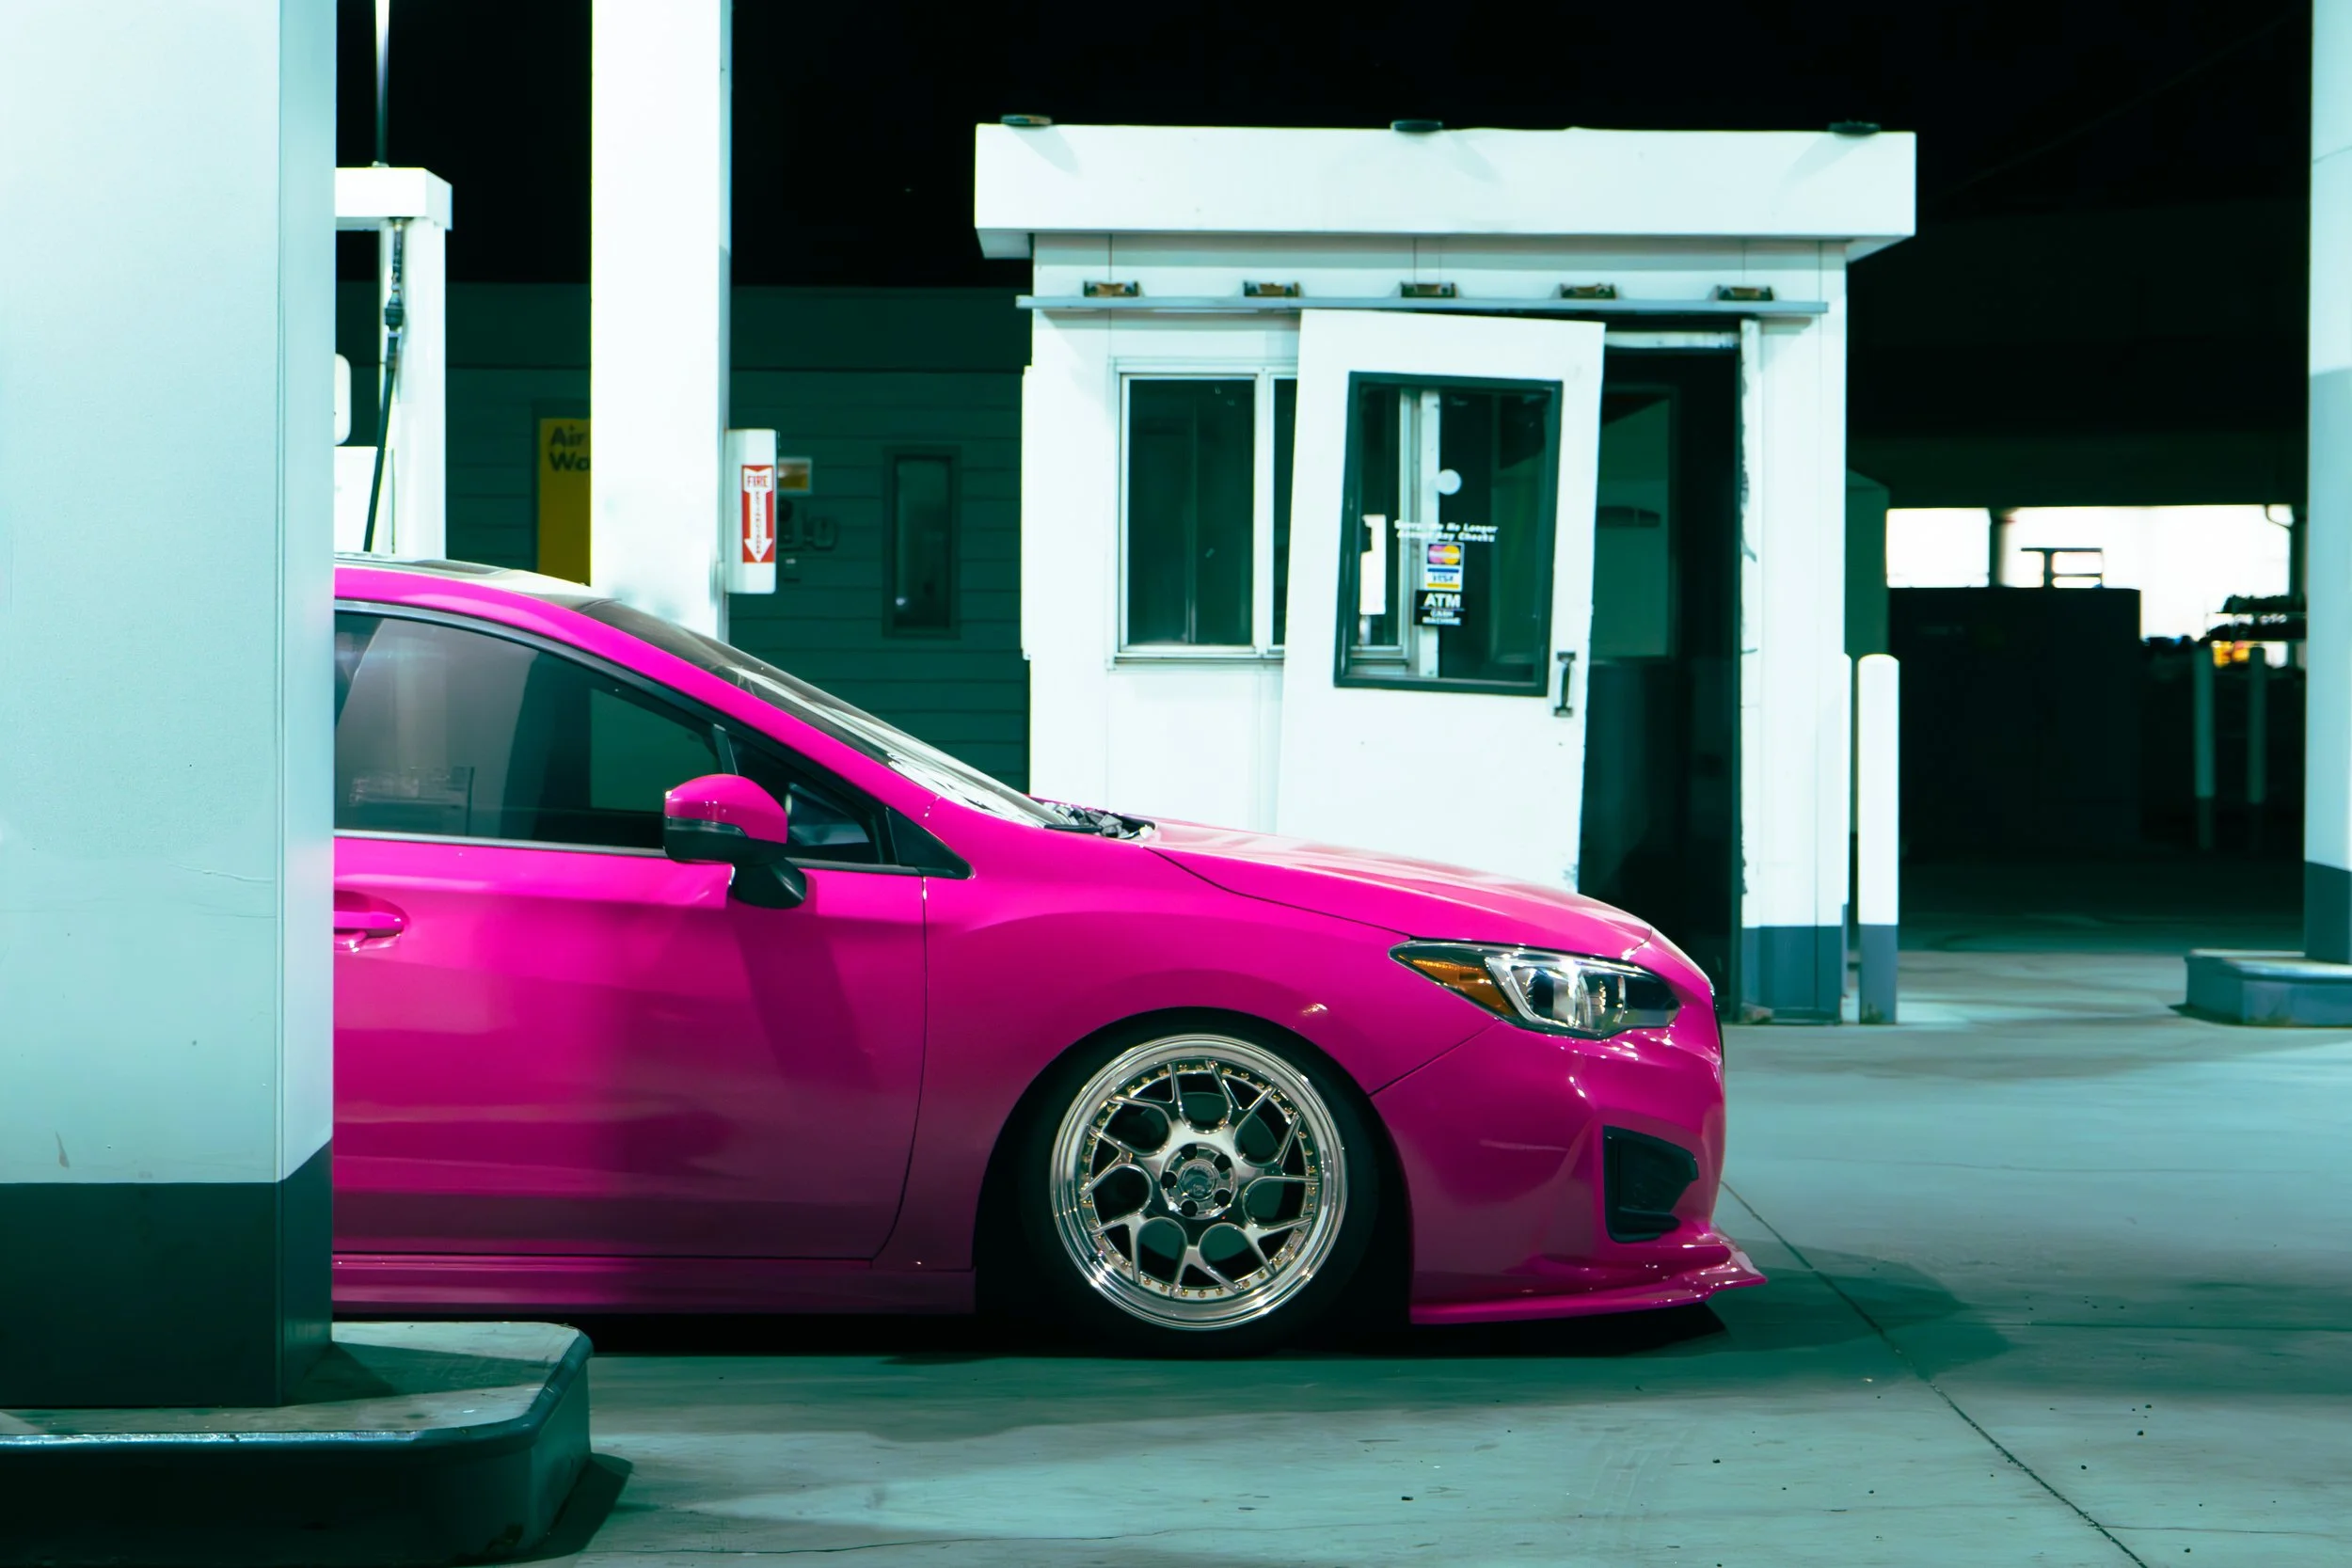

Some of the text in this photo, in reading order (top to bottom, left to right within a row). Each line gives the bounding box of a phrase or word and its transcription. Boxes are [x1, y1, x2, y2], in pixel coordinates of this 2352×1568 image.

[550, 424, 587, 447] Air
[747, 475, 768, 487] FIRE
[1463, 522, 1499, 533] Longer
[1457, 531, 1495, 543] Checks
[1423, 593, 1461, 609] ATM
